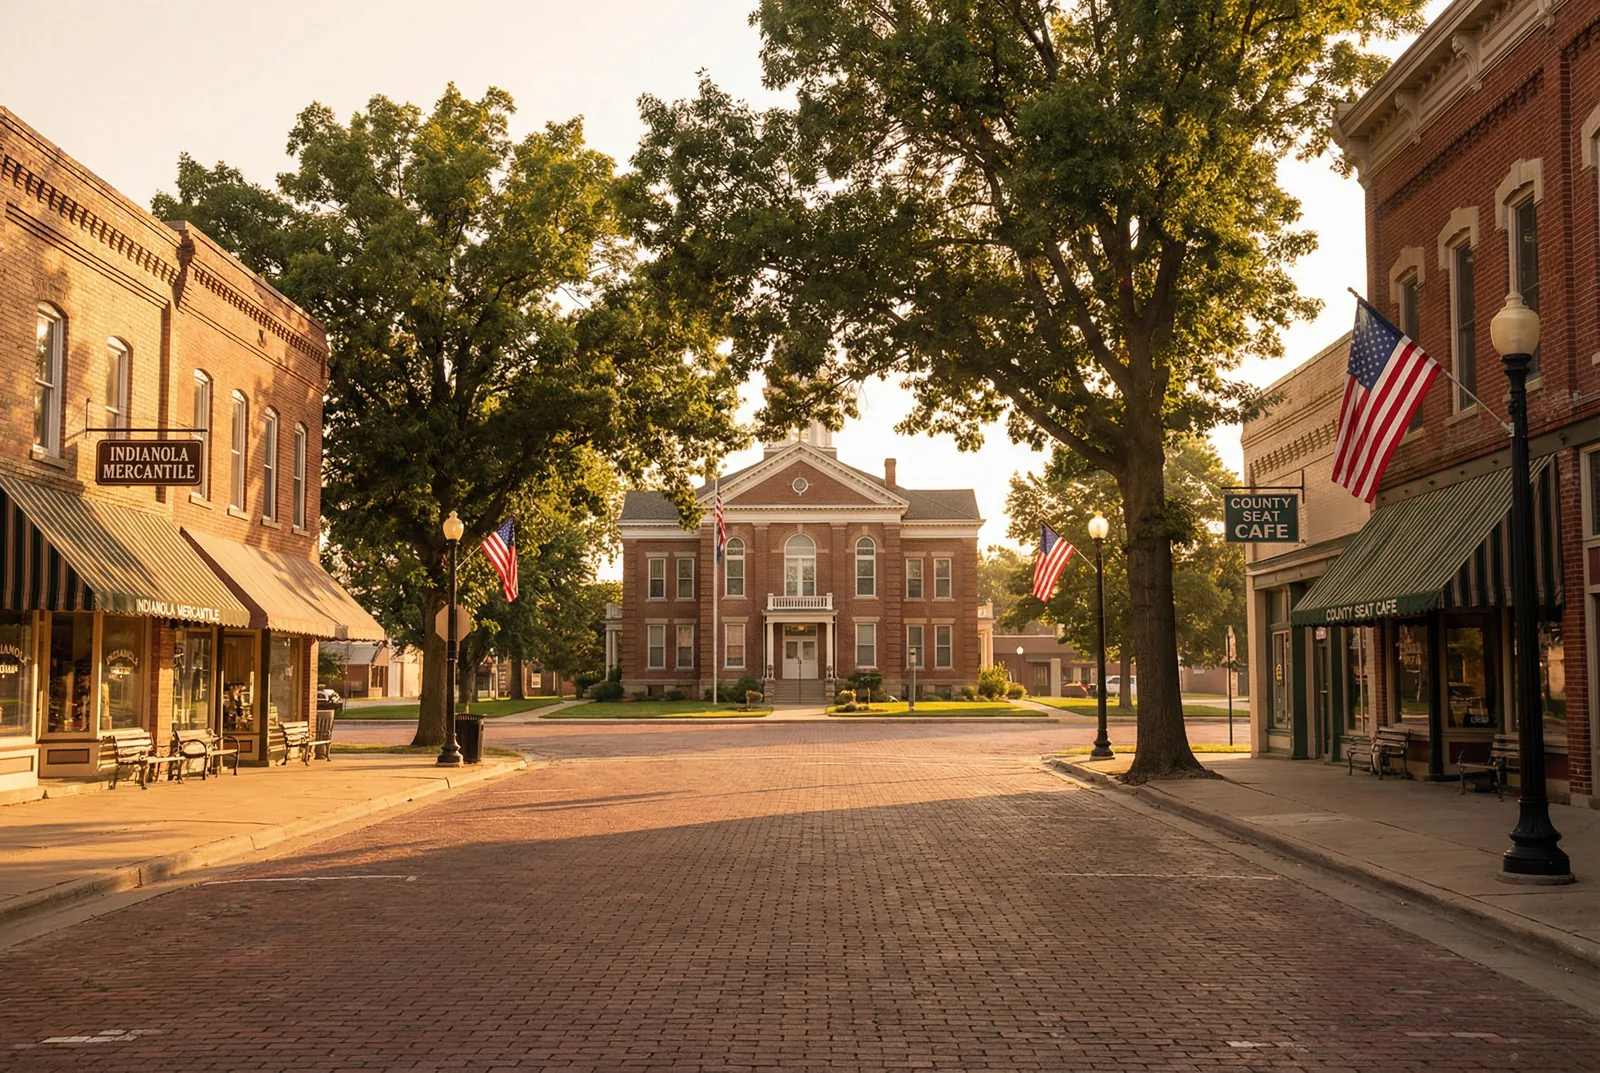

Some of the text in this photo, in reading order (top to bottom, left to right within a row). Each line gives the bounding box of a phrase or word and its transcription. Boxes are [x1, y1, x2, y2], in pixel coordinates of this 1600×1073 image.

[110, 446, 189, 462] INDIANOLA
[103, 464, 195, 479] MERCANTILE
[1230, 497, 1291, 509] COUNTY
[1242, 510, 1281, 522] SEAT
[1234, 524, 1289, 539] CAFE
[136, 598, 220, 621] INDIANOLA MERCANTILE
[1326, 599, 1398, 621] COUNTY SEAT CAFE
